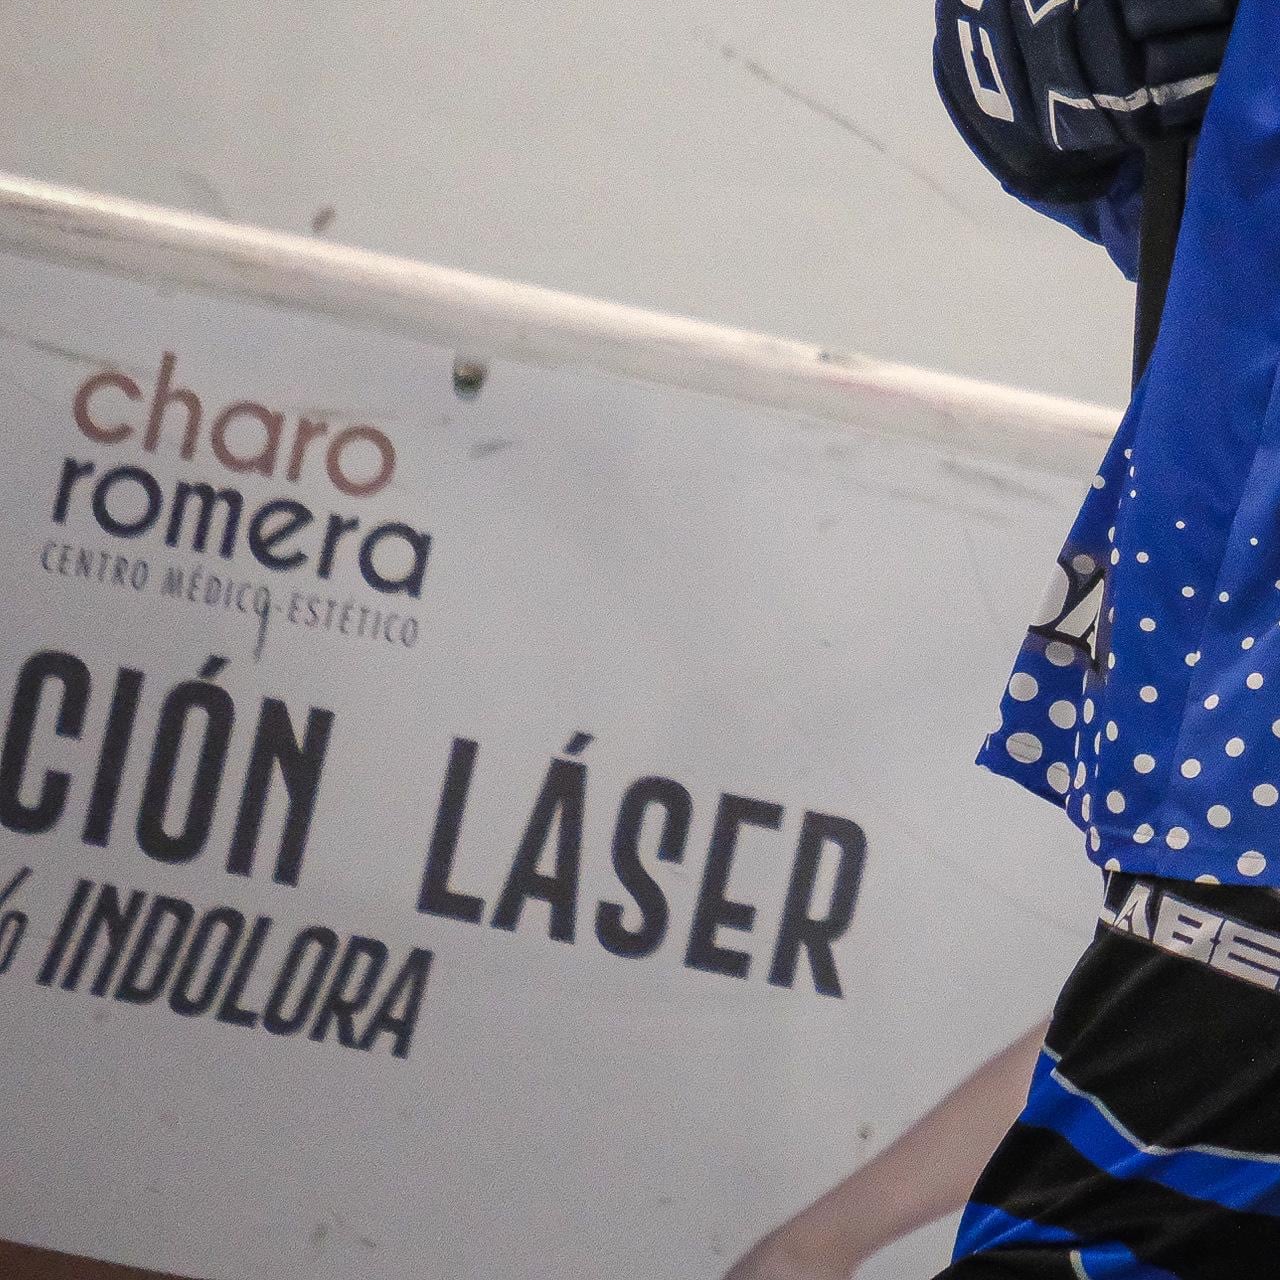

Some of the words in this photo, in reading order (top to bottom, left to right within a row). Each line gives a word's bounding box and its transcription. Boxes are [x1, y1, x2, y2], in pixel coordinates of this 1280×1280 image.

[72, 351, 396, 497] charo
[40, 540, 150, 591] CENTRO
[51, 456, 432, 598] romera
[0, 649, 335, 888] CIÓN
[417, 731, 869, 999] LÁSER
[36, 878, 435, 1059] INDOLORA
